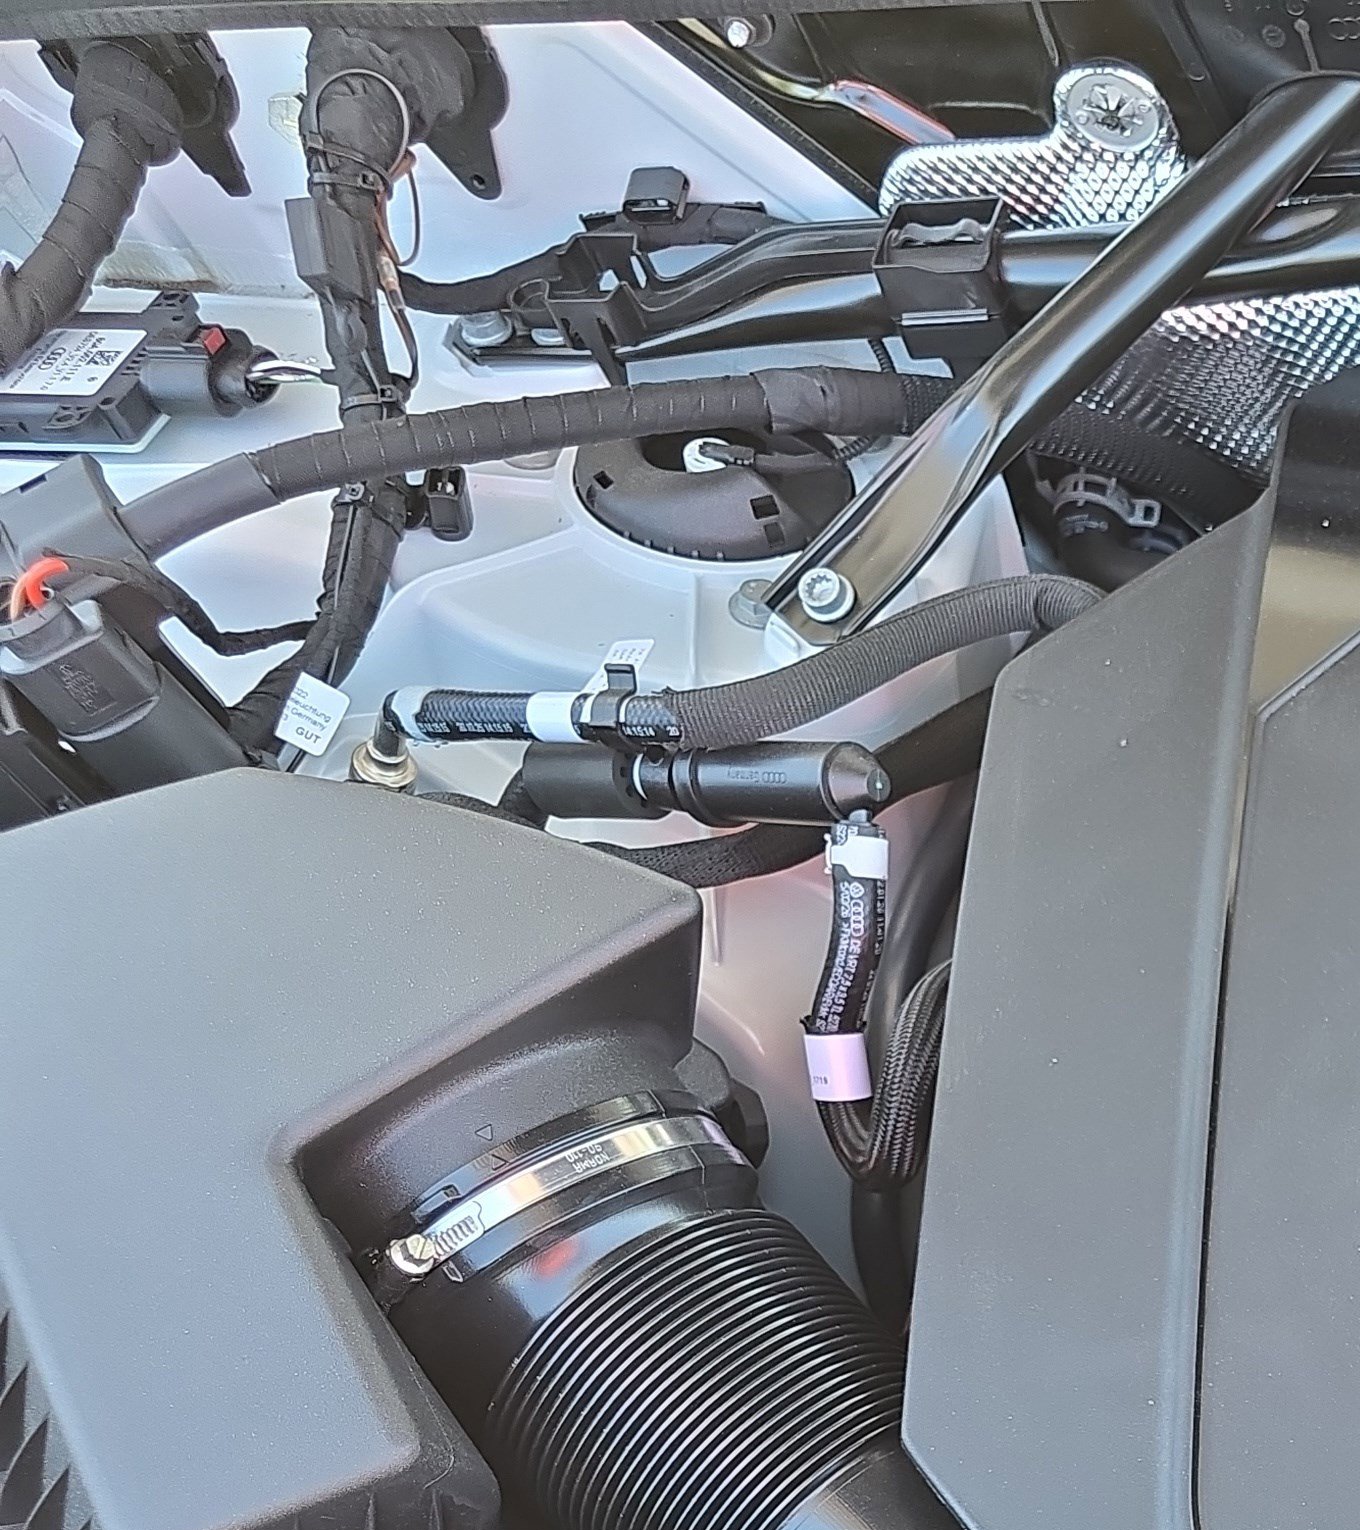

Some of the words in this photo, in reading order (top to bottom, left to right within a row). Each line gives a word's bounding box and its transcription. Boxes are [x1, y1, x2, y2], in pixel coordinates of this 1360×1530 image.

[291, 707, 327, 731] Germany
[295, 726, 322, 744] GUT
[572, 1151, 611, 1173] NORMA
